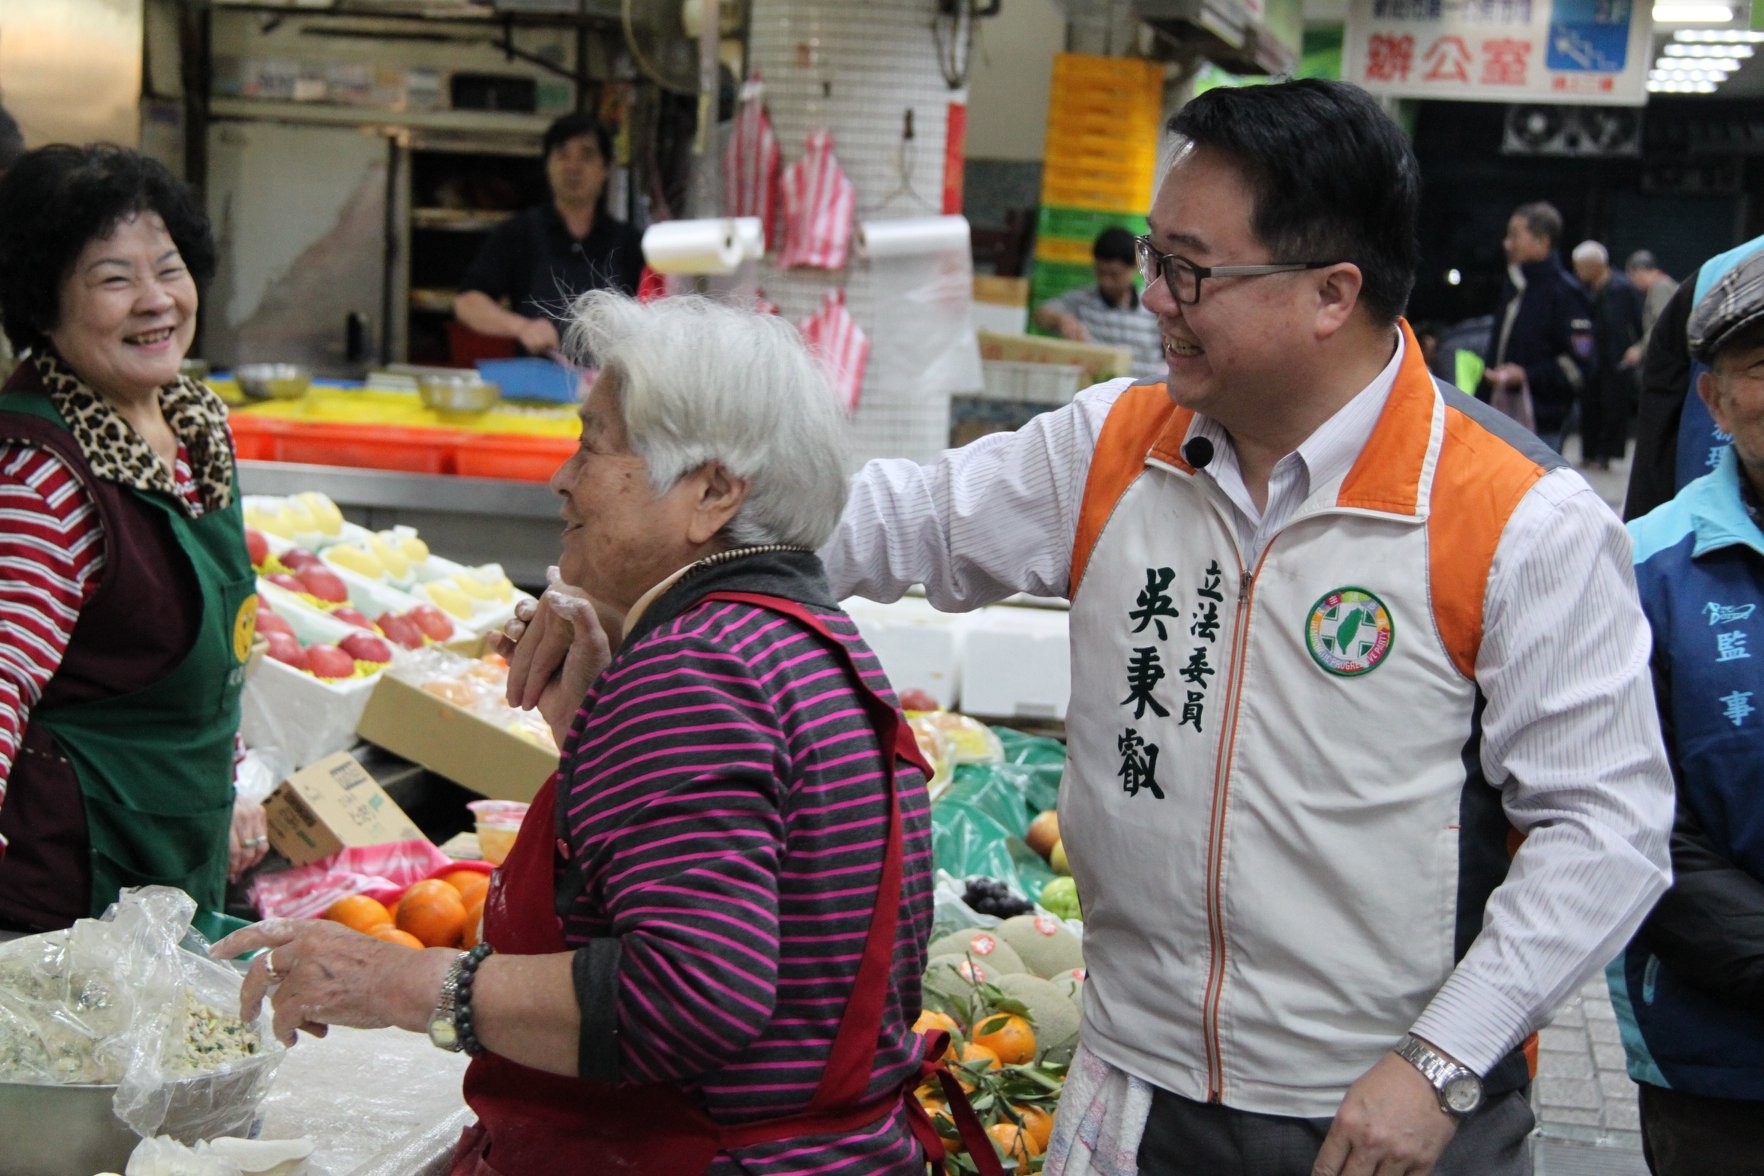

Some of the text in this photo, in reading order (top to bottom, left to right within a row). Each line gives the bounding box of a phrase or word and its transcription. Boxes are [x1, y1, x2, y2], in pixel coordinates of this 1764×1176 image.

[1365, 33, 1532, 86] 辦公室
[1117, 567, 1178, 799] 吳秉叡
[1178, 560, 1224, 733] 立法委員
[1715, 630, 1756, 726] 監事
